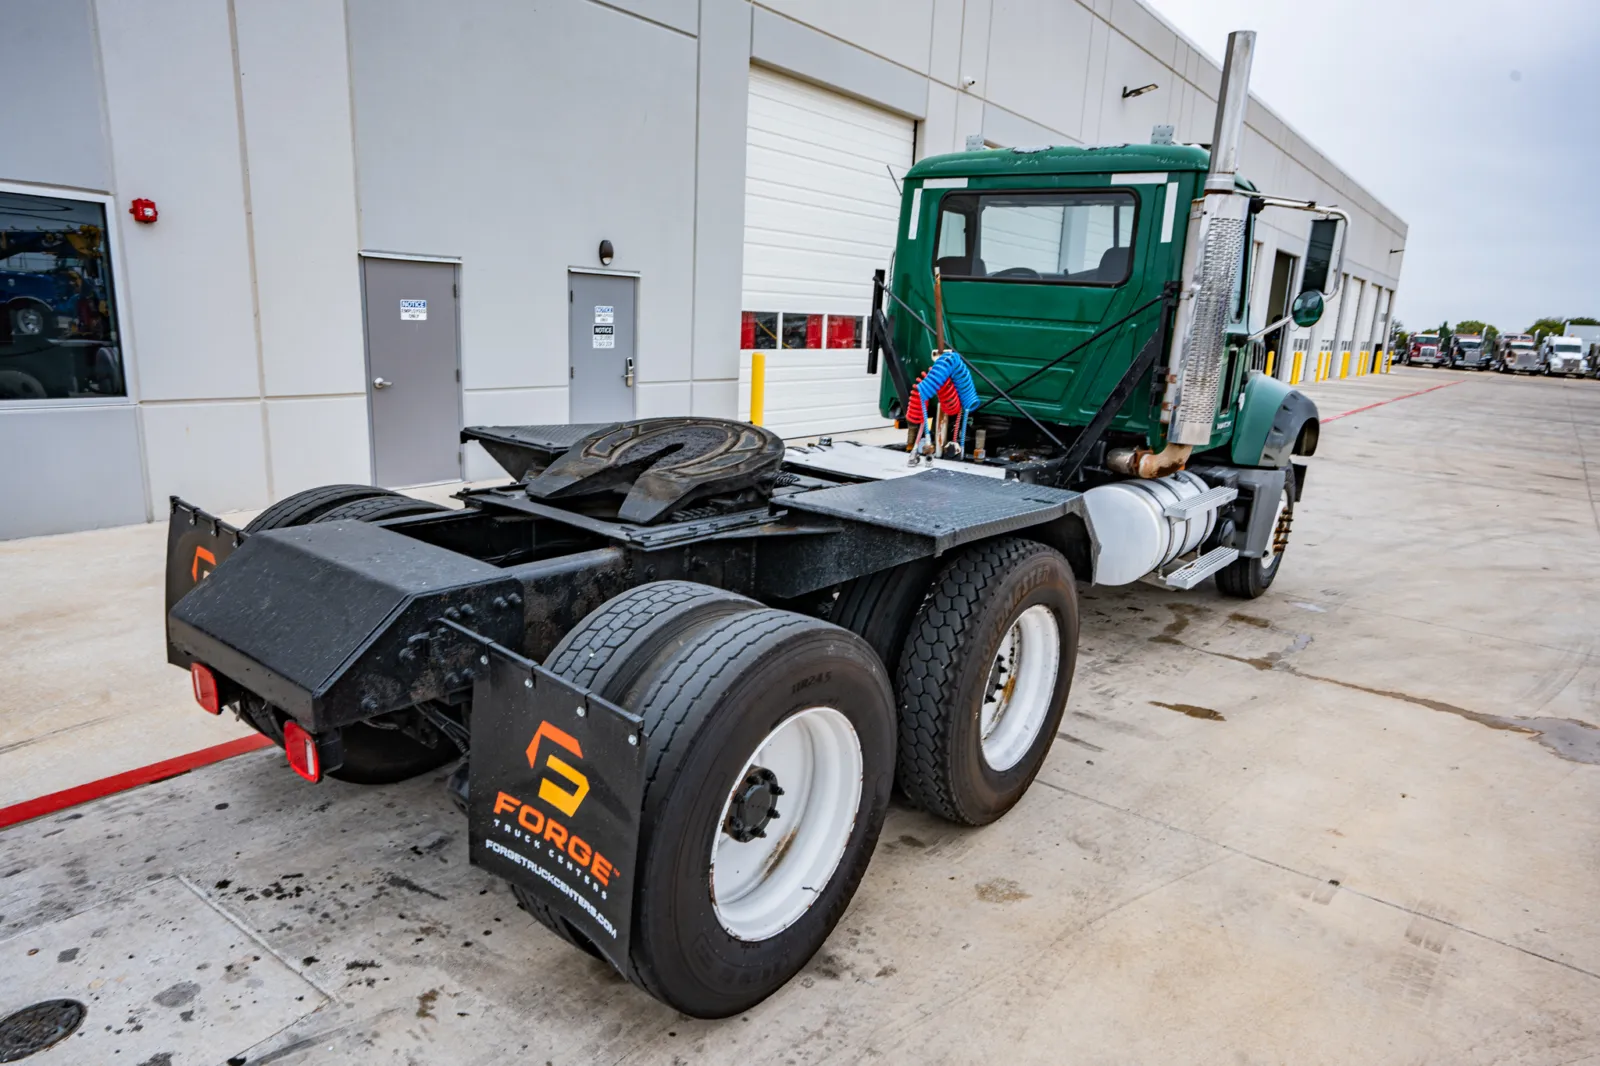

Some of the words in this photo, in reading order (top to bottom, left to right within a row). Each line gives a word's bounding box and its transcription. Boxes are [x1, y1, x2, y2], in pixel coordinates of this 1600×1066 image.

[493, 791, 614, 887] FORGE
[494, 818, 541, 849] TRUCK
[548, 848, 608, 900] CENTERS
[485, 838, 618, 939] FORGETRUCKCENTERS.COM
